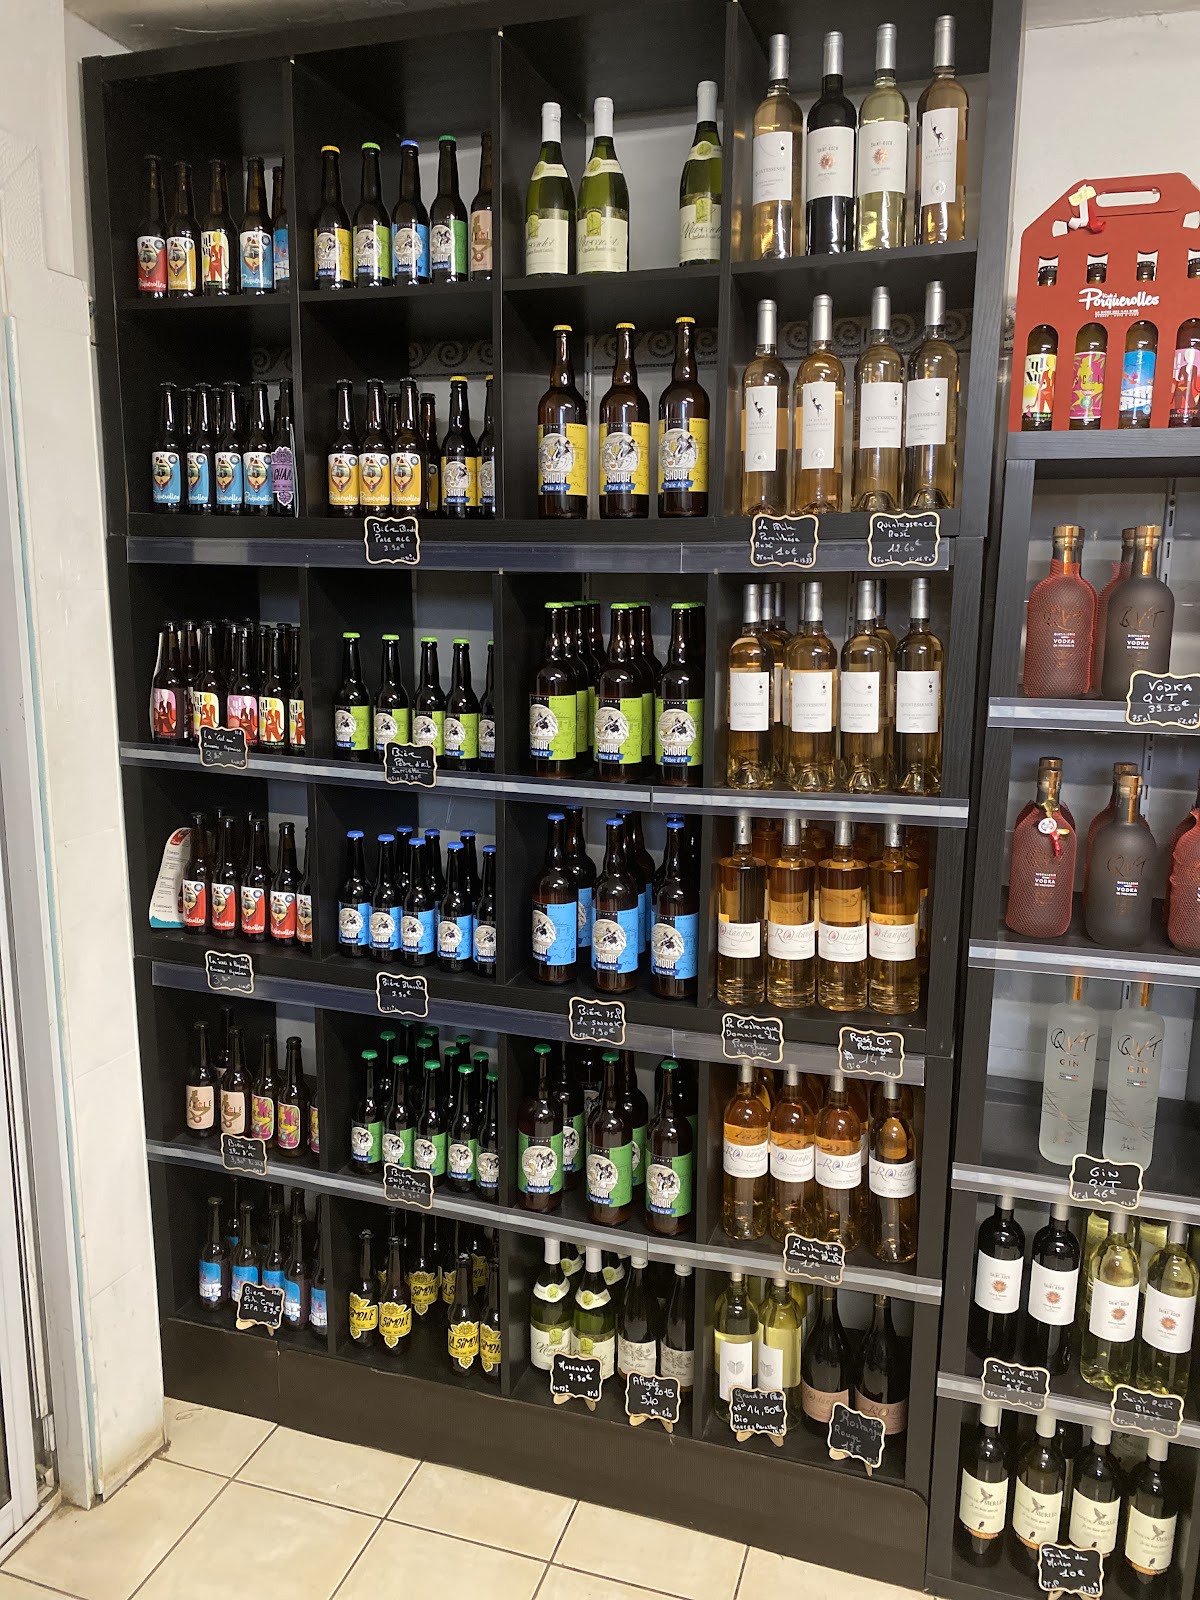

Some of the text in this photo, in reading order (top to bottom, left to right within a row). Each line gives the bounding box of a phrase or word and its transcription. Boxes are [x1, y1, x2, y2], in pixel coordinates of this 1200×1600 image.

[1078, 288, 1159, 311] Porquerolles
[372, 523, 398, 533] Bière
[888, 530, 911, 538] Rosé
[776, 547, 797, 556] 10€
[1148, 700, 1190, 713] 39.50€
[1132, 714, 1151, 722] 75cl
[392, 748, 421, 759] Bière
[382, 978, 400, 987] Bière
[577, 1005, 602, 1016] Bière
[737, 1020, 780, 1033] Rostangue
[726, 1030, 761, 1039] Domaine
[877, 1037, 891, 1045] Or
[857, 1043, 893, 1054] Rostangue
[859, 1054, 886, 1065] 14€
[1059, 1059, 1079, 1067] GIN
[1094, 1189, 1117, 1198] 46€
[1002, 1374, 1028, 1386] Rouge
[747, 1404, 782, 1416] 14,50€
[1135, 1405, 1162, 1416] Blanc
[734, 1414, 748, 1423] Bio
[834, 1424, 861, 1442] Rouge
[1059, 1569, 1085, 1577] 10€
